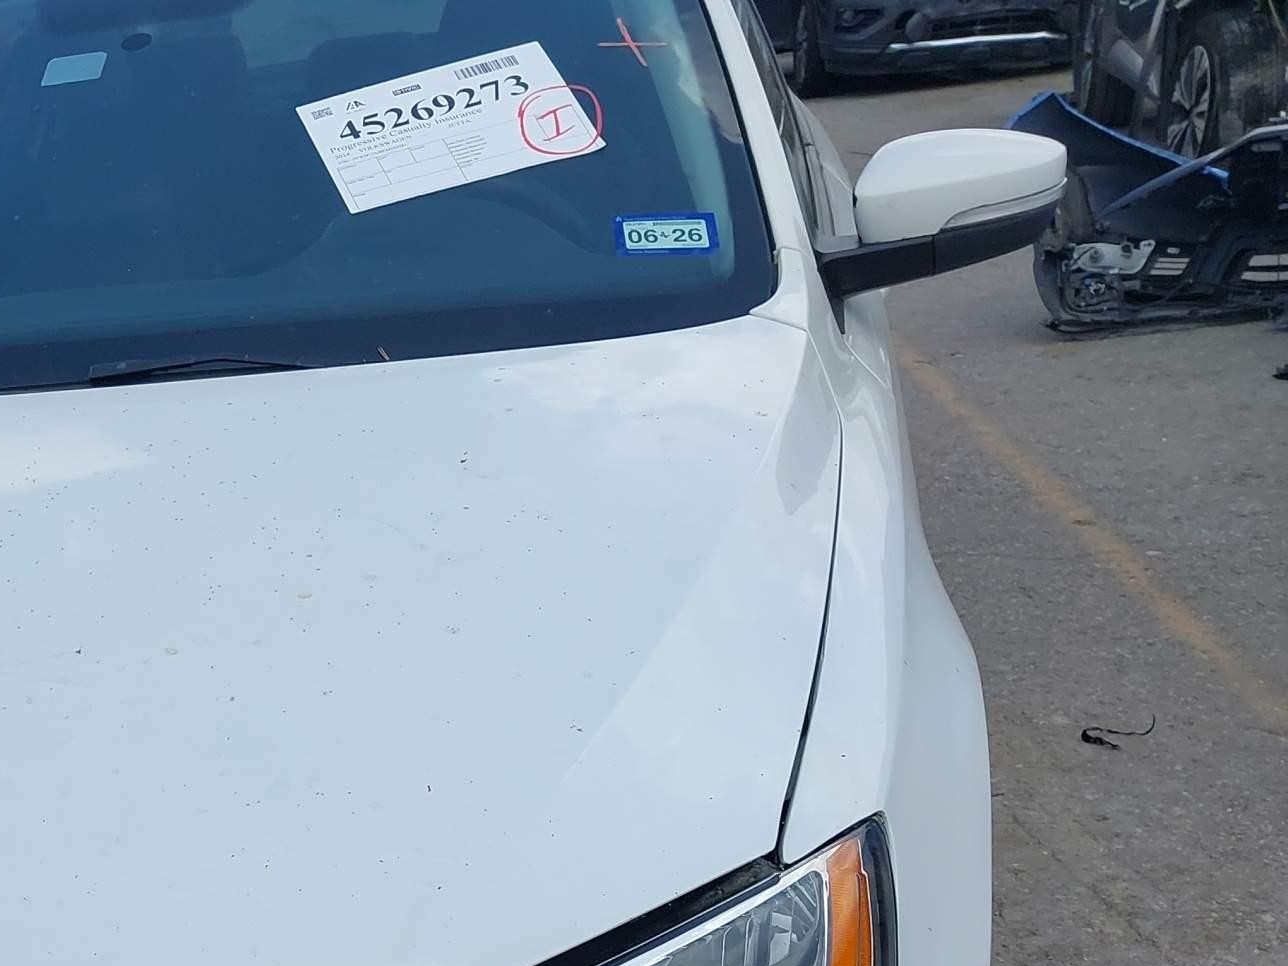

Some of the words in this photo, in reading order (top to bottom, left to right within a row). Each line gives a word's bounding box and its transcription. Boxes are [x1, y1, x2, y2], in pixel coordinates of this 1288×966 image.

[339, 74, 529, 140] 45269273
[329, 133, 387, 153] Progressive
[389, 121, 432, 137] Casualty
[434, 109, 482, 125] Insurance
[628, 229, 658, 243] 06
[672, 228, 703, 242] 26
